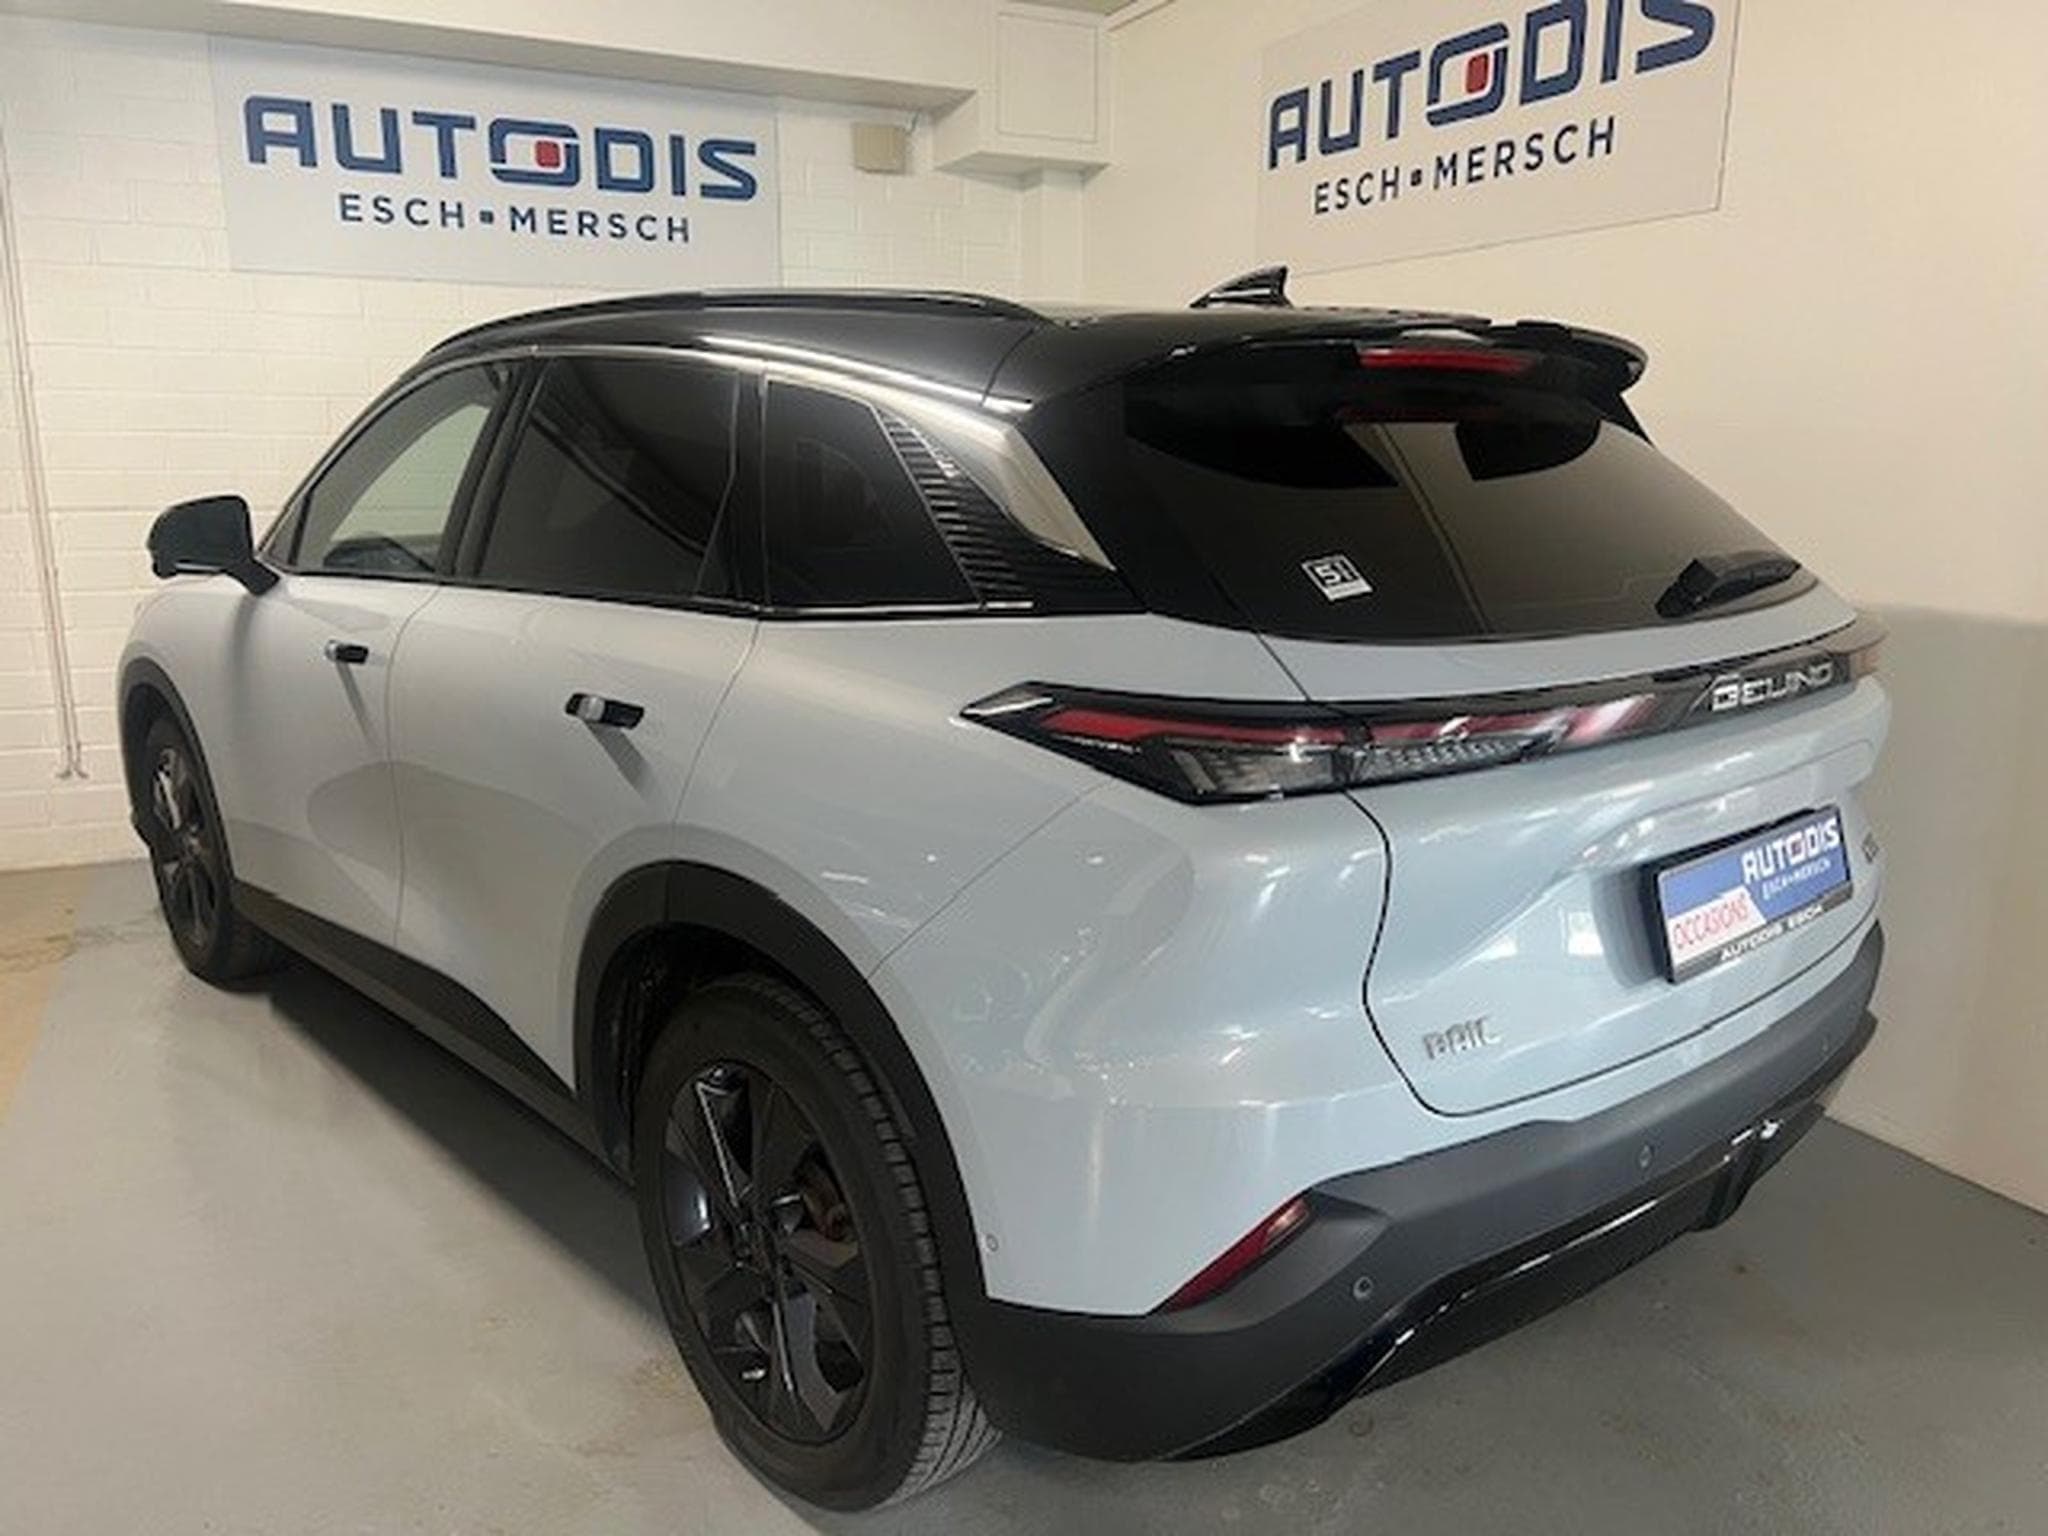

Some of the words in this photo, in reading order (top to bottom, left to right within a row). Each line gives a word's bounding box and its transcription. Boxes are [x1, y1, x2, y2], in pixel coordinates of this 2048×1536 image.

[1267, 0, 1715, 170] AUTODIS
[244, 94, 758, 202] AUTODIS
[1314, 166, 1399, 215] ESCH
[1433, 115, 1615, 191] MERSCH
[340, 193, 465, 228] ESCH
[510, 206, 690, 242] MERSCH
[1741, 816, 1841, 884] AUTODIS
